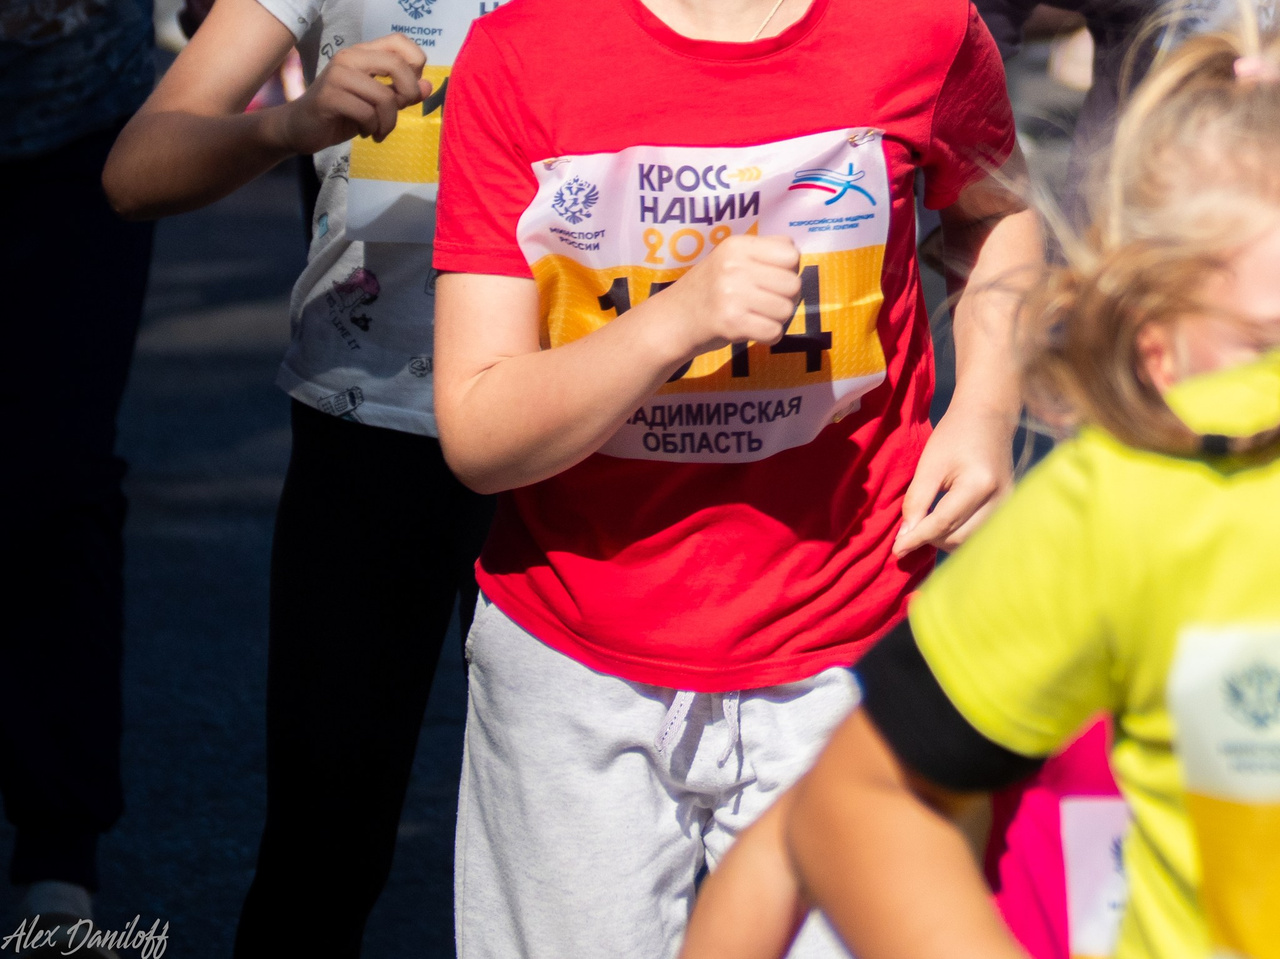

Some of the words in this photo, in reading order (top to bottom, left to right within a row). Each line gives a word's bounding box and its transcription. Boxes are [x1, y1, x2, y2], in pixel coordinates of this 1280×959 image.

[391, 24, 443, 36] МИНСПОРТ
[638, 163, 731, 191] КРОСС
[640, 191, 761, 226] НАЦИИ
[643, 431, 763, 454] ОБЛАСТЬ
